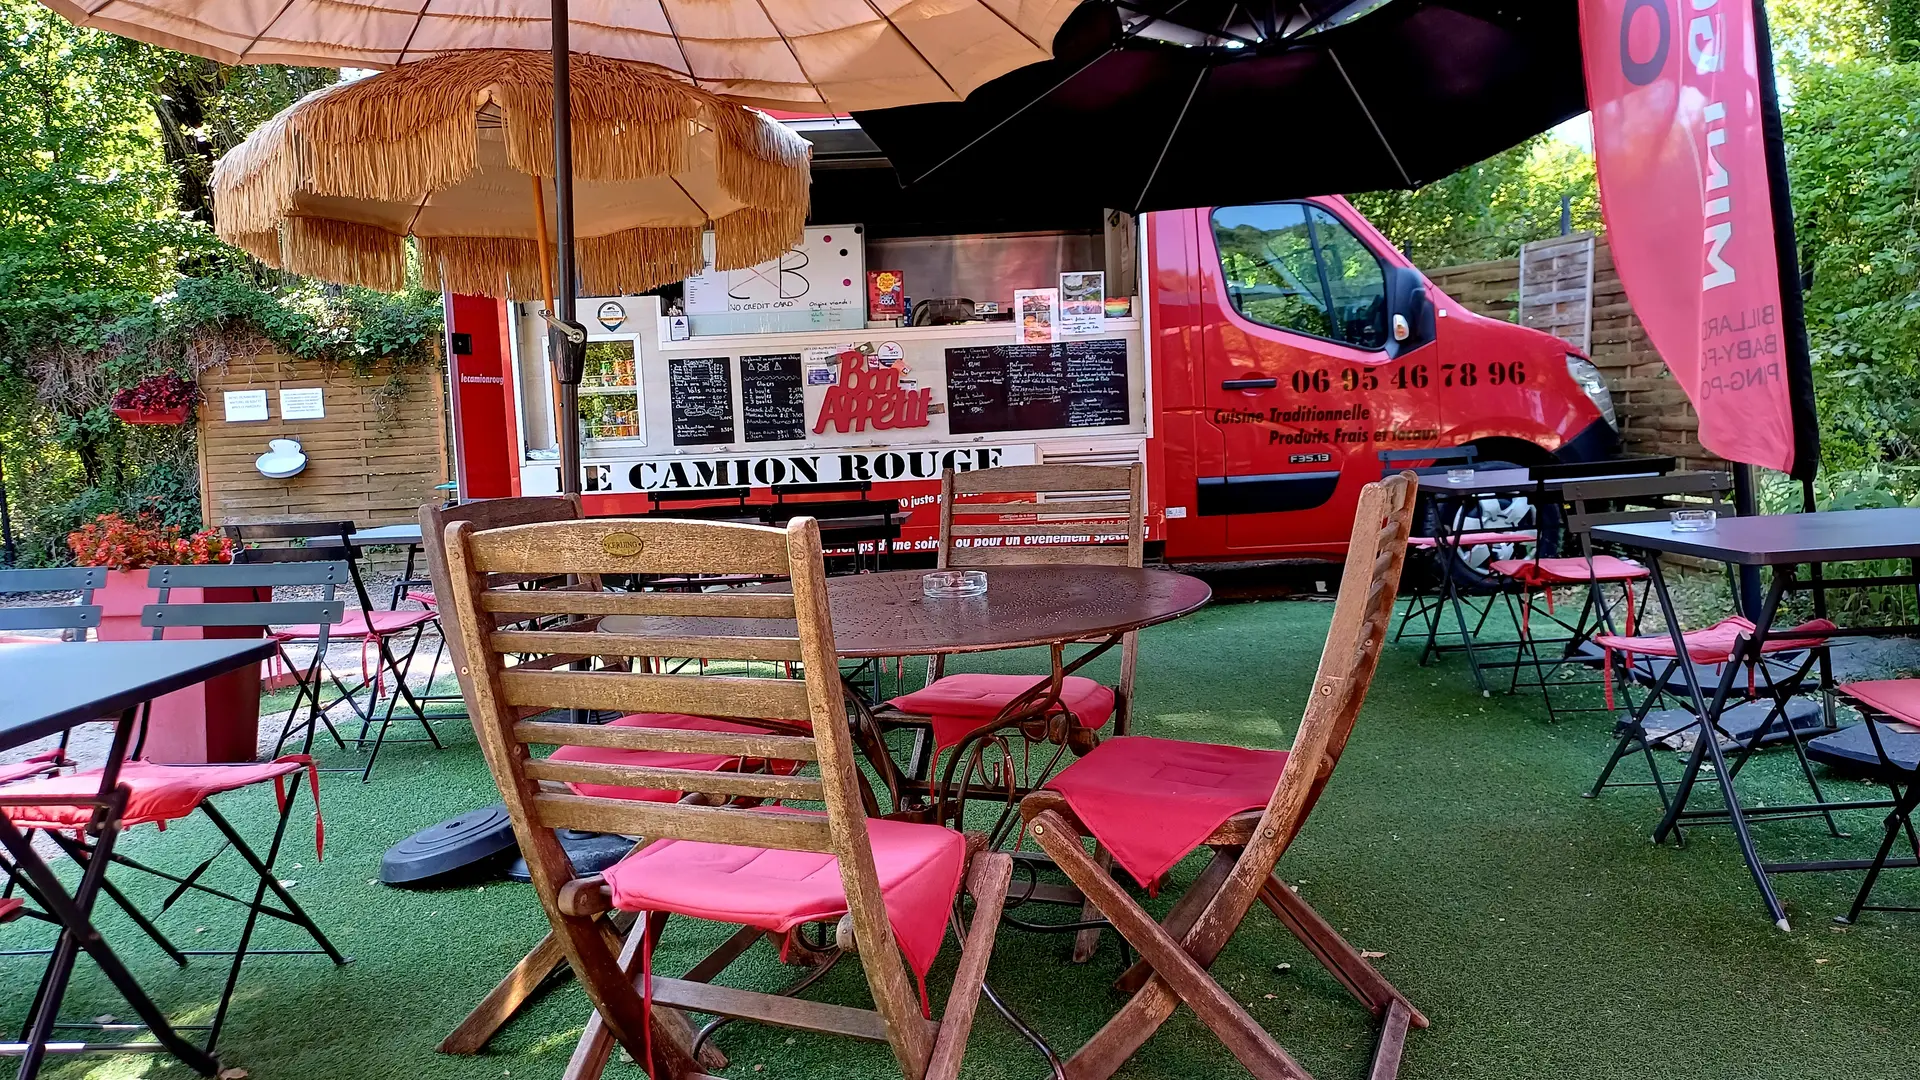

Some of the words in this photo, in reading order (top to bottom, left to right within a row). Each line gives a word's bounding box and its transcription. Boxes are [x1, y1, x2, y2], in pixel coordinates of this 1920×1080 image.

[730, 303, 741, 311] NO
[840, 350, 899, 393] Bon
[1291, 369, 1331, 394] 06
[1341, 367, 1379, 391] 95
[1390, 364, 1429, 389] 46
[1440, 363, 1478, 387] 78
[1488, 361, 1526, 385] 96
[1214, 407, 1264, 425] Cuisine
[1269, 404, 1370, 422] Traditionnelle
[1269, 428, 1330, 445] Produits
[1333, 428, 1369, 443] Frais
[1373, 426, 1388, 442] et
[628, 456, 821, 490] CAMION
[837, 448, 1003, 482] ROUGE
[911, 494, 935, 508] juste
[955, 537, 971, 547] ou
[974, 535, 1003, 547] pour
[1005, 535, 1020, 545] un
